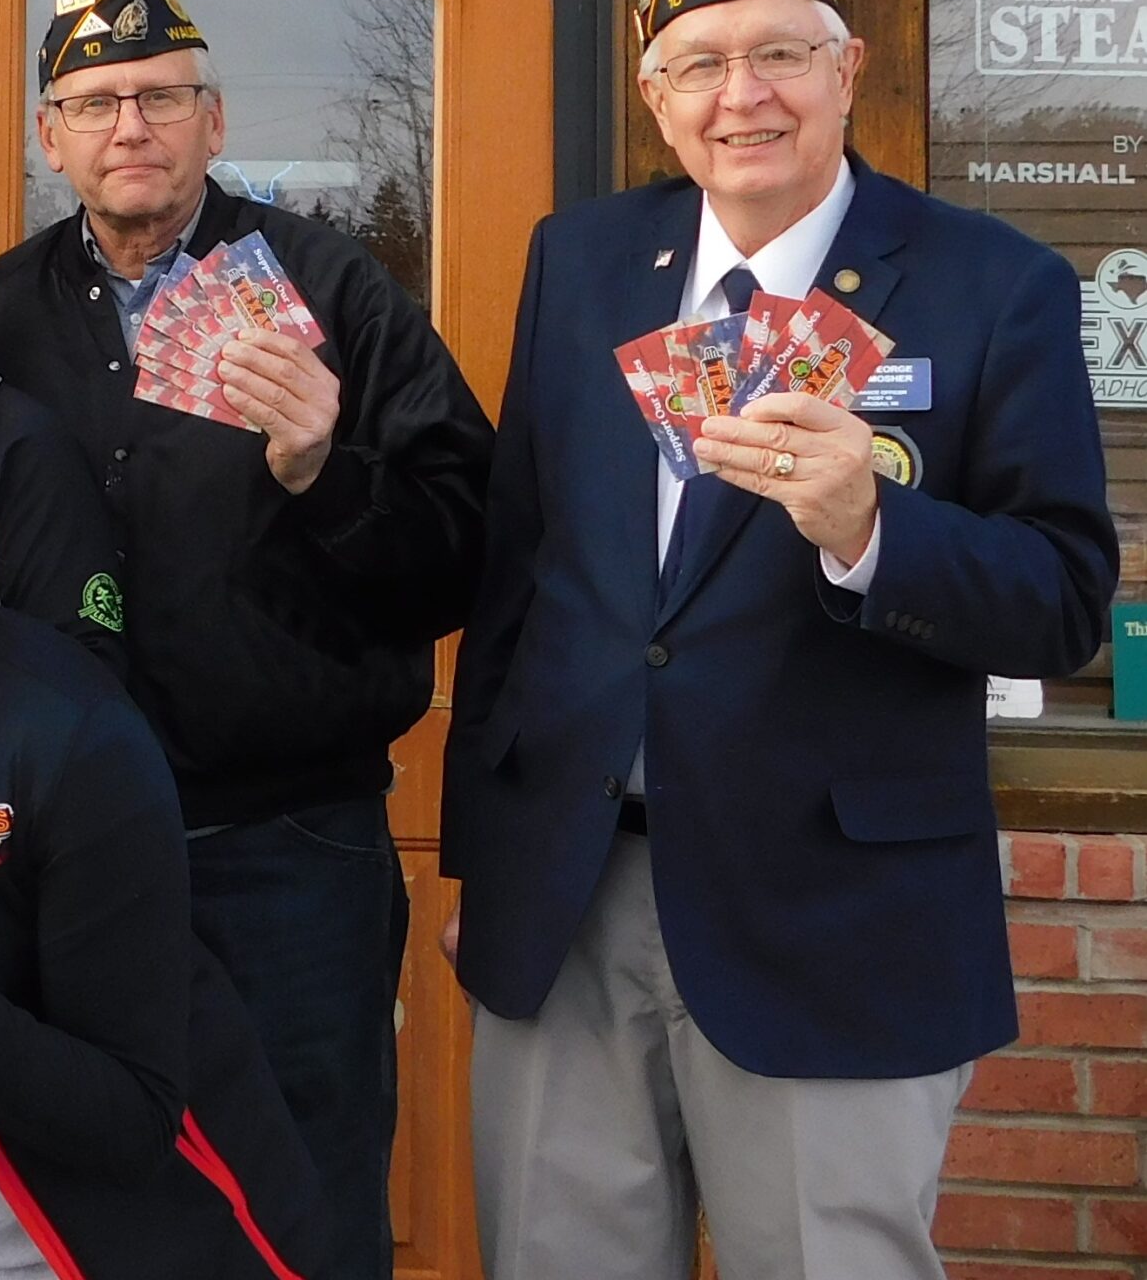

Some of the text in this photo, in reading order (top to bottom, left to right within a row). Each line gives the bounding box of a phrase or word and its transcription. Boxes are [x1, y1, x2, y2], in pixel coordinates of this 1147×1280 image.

[83, 42, 101, 57] 10
[1112, 135, 1143, 153] BY
[968, 161, 1136, 185] MARSHALL
[253, 248, 279, 287] Support
[275, 283, 291, 302] Our
[747, 364, 781, 400] Support
[776, 342, 796, 365] Our
[875, 365, 913, 373] EORGE
[651, 397, 666, 419] Our
[660, 419, 687, 462] Support
